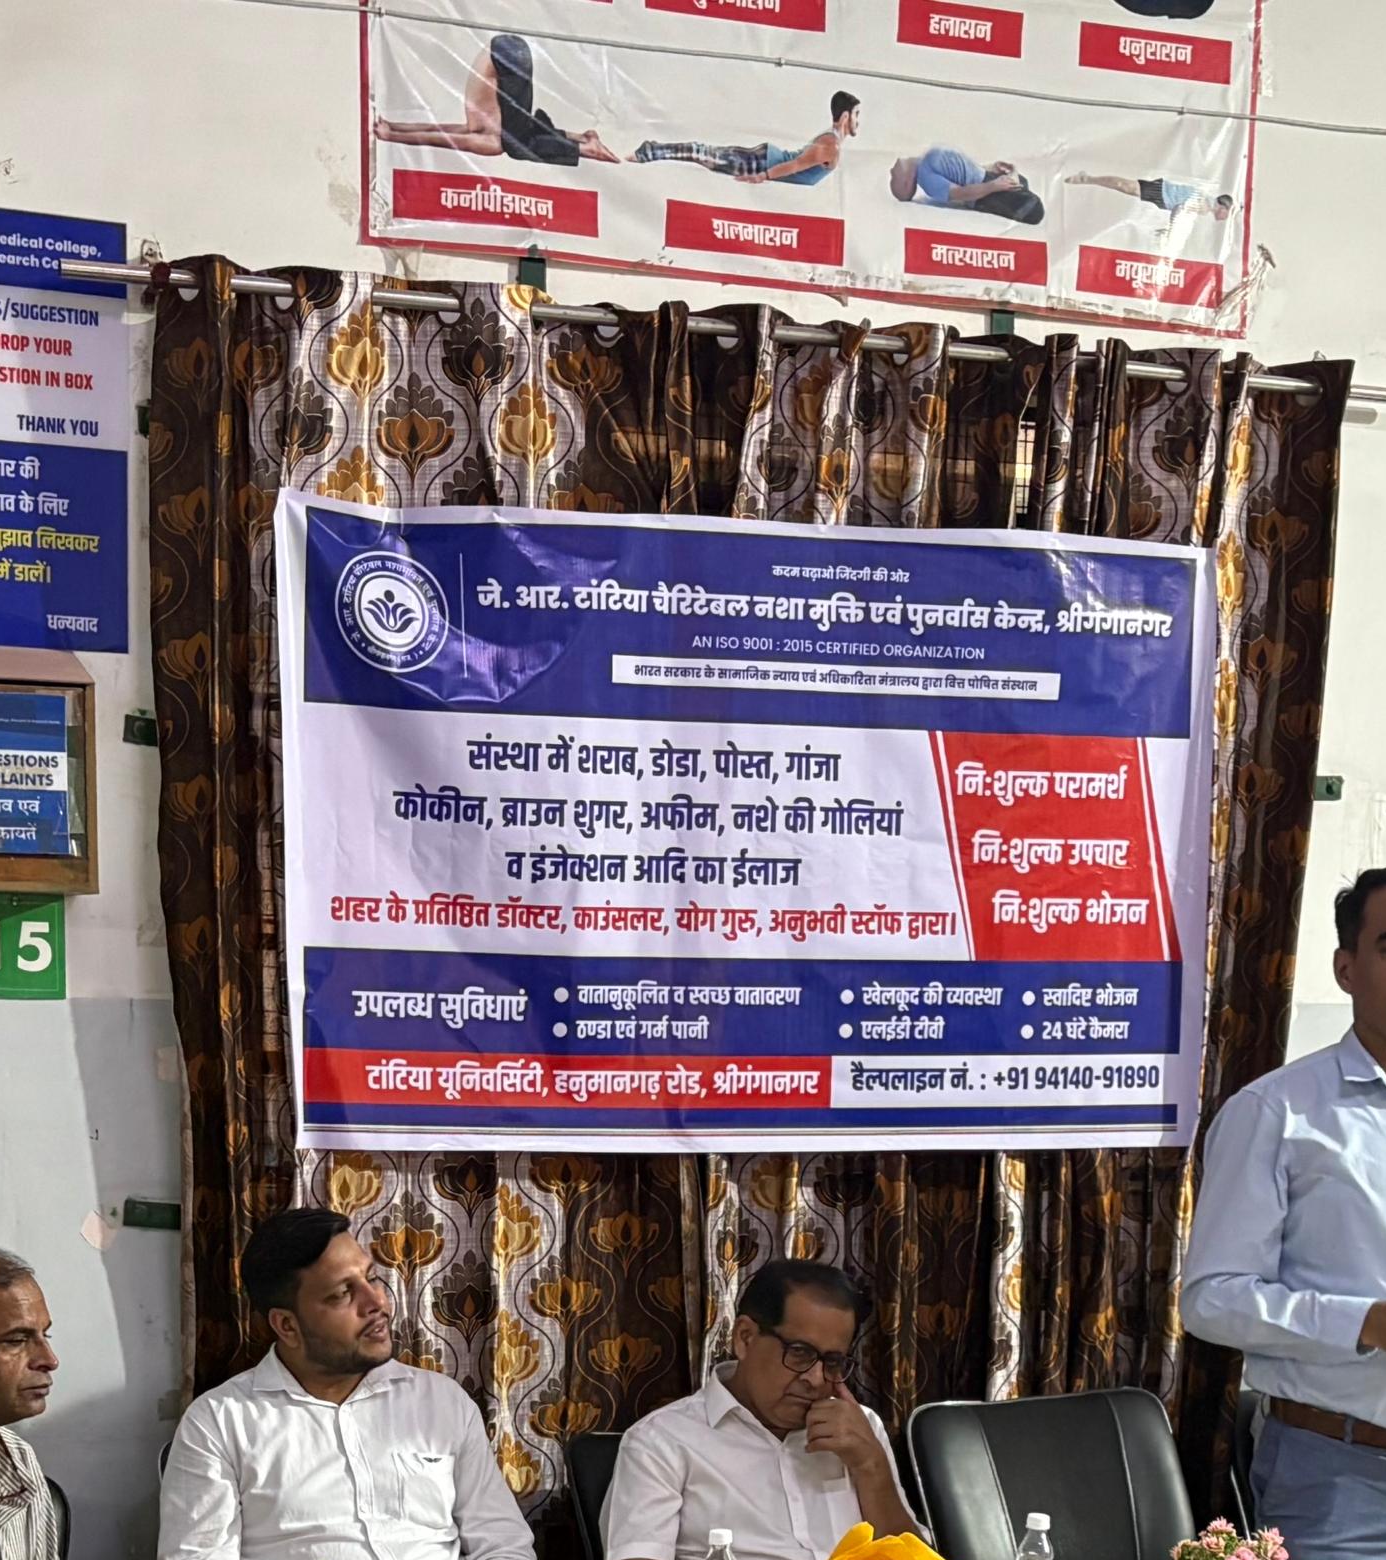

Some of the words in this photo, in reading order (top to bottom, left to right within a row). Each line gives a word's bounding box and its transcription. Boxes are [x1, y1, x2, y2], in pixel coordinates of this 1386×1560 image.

[929, 14, 992, 42] हलासन
[1119, 35, 1192, 65] धनुरासन
[45, 238, 102, 258] College,
[34, 337, 72, 356] YOUR
[45, 370, 59, 387] IN
[64, 372, 93, 390] BOX
[17, 414, 66, 434] THANK
[70, 419, 99, 437] YOU
[20, 456, 40, 479] की
[19, 491, 33, 513] के
[37, 492, 69, 516] लिए
[37, 527, 100, 552] लिखकर
[772, 565, 800, 577] कदम
[873, 567, 888, 582] की
[477, 578, 510, 610] जे.
[515, 583, 569, 611] आर.
[574, 579, 648, 614] टांटिया
[652, 581, 751, 617] चैरिटेबल
[754, 595, 804, 620] नशा
[808, 592, 865, 631] मुक्ति
[869, 595, 903, 625] एवं
[907, 598, 990, 635] पुनर्वास
[1055, 602, 1173, 637] श्रीगंगानगर
[47, 613, 98, 633] धन्यवाद
[692, 635, 712, 648] AN
[716, 636, 739, 649] ISO
[743, 637, 774, 651] 9001
[783, 639, 813, 652] 2015
[816, 640, 880, 656] CERTIFIED
[883, 642, 985, 660] ORGANIZATION
[634, 664, 661, 677] भारत
[664, 666, 701, 679] सरकार
[704, 665, 715, 679] के
[718, 666, 770, 680] सामाजिक
[773, 670, 799, 682] न्याय
[802, 669, 817, 683] एवं
[819, 670, 876, 686] अधिकारिता
[878, 672, 920, 687] मंत्रालय
[968, 675, 998, 690] पोषित
[1001, 676, 1037, 692] संस्थान
[467, 733, 541, 772] संस्था
[546, 735, 574, 773] में
[577, 745, 644, 781] शराब,
[650, 739, 707, 783] डोडा,
[713, 741, 779, 785] पोस्त,
[785, 745, 841, 781] गांजा
[1053, 765, 1129, 800] परामर्श
[18, 796, 40, 813] एवं
[393, 784, 493, 830] कोकीन,
[500, 797, 567, 827] ब्राउन
[574, 799, 633, 838] शुगर,
[641, 794, 726, 837] अफीम,
[732, 796, 778, 833] नशे
[783, 796, 816, 834] की
[821, 799, 904, 837] गोलियां
[1067, 839, 1129, 866] उपचार
[506, 851, 525, 879] व
[531, 844, 627, 884] इंजेक्शन
[634, 847, 688, 884] आदि
[693, 856, 727, 884] का
[731, 848, 802, 888] ईलाज
[331, 895, 382, 923] शहर
[386, 891, 408, 923] के
[412, 892, 491, 928] प्रतिष्ठित
[495, 896, 567, 934] डॉक्टर,
[573, 900, 670, 936] काउंसलर,
[675, 900, 717, 933] योग
[769, 903, 846, 942] अनुभवी
[851, 903, 903, 935] स्टॉफ
[1085, 890, 1149, 925] भोजन
[352, 990, 433, 1020] उपलब्ध
[440, 986, 528, 1028] सुविधाएं
[577, 980, 669, 1010] वातानुकूलित
[673, 987, 685, 1004] व
[688, 988, 731, 1005] स्वच्छ
[735, 987, 801, 1006] वातावरण
[862, 982, 920, 1011] खेलकूद
[923, 982, 944, 1006] की
[947, 987, 1003, 1006] व्यवस्था
[1095, 983, 1138, 1006] भोजन
[576, 1019, 612, 1040] ठण्डा
[615, 1016, 636, 1039] एवं
[640, 1015, 668, 1039] गर्म
[671, 1015, 709, 1040] पानी
[861, 1016, 912, 1041] एलईडी
[914, 1016, 945, 1039] टीवी
[1042, 1022, 1062, 1039] 24
[1089, 1017, 1129, 1039] कैमरा
[366, 1059, 432, 1091] टांटिया
[665, 1064, 707, 1097] रोड,
[713, 1063, 820, 1094] श्रीगंगानगर
[993, 1067, 1029, 1090] +91
[1034, 1065, 1159, 1089] 94140-91890
